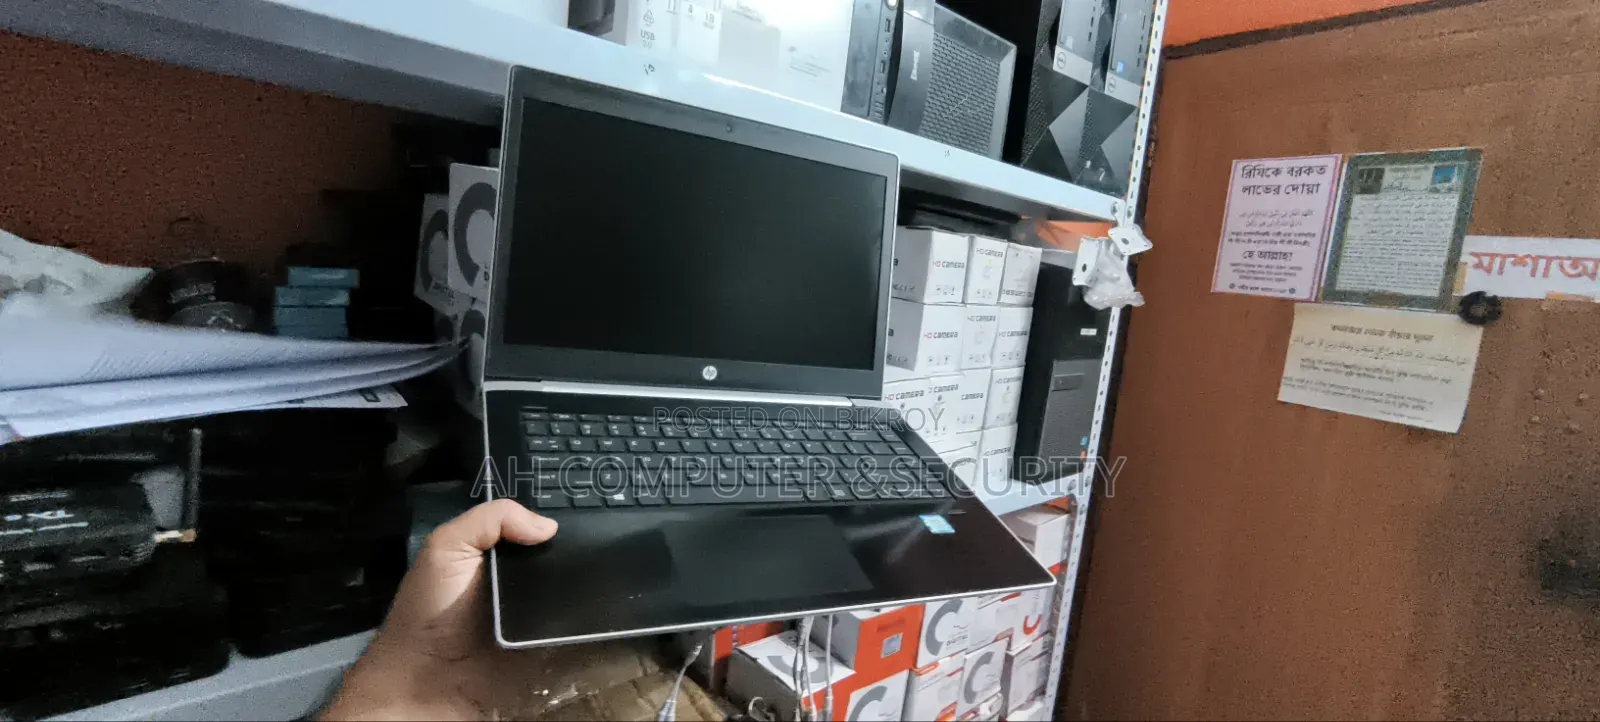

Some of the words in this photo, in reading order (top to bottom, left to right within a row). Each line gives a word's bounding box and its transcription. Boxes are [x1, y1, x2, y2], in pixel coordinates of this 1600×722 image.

[640, 29, 655, 41] USB
[1287, 164, 1328, 178] বরকত
[1242, 184, 1281, 196] লাভের
